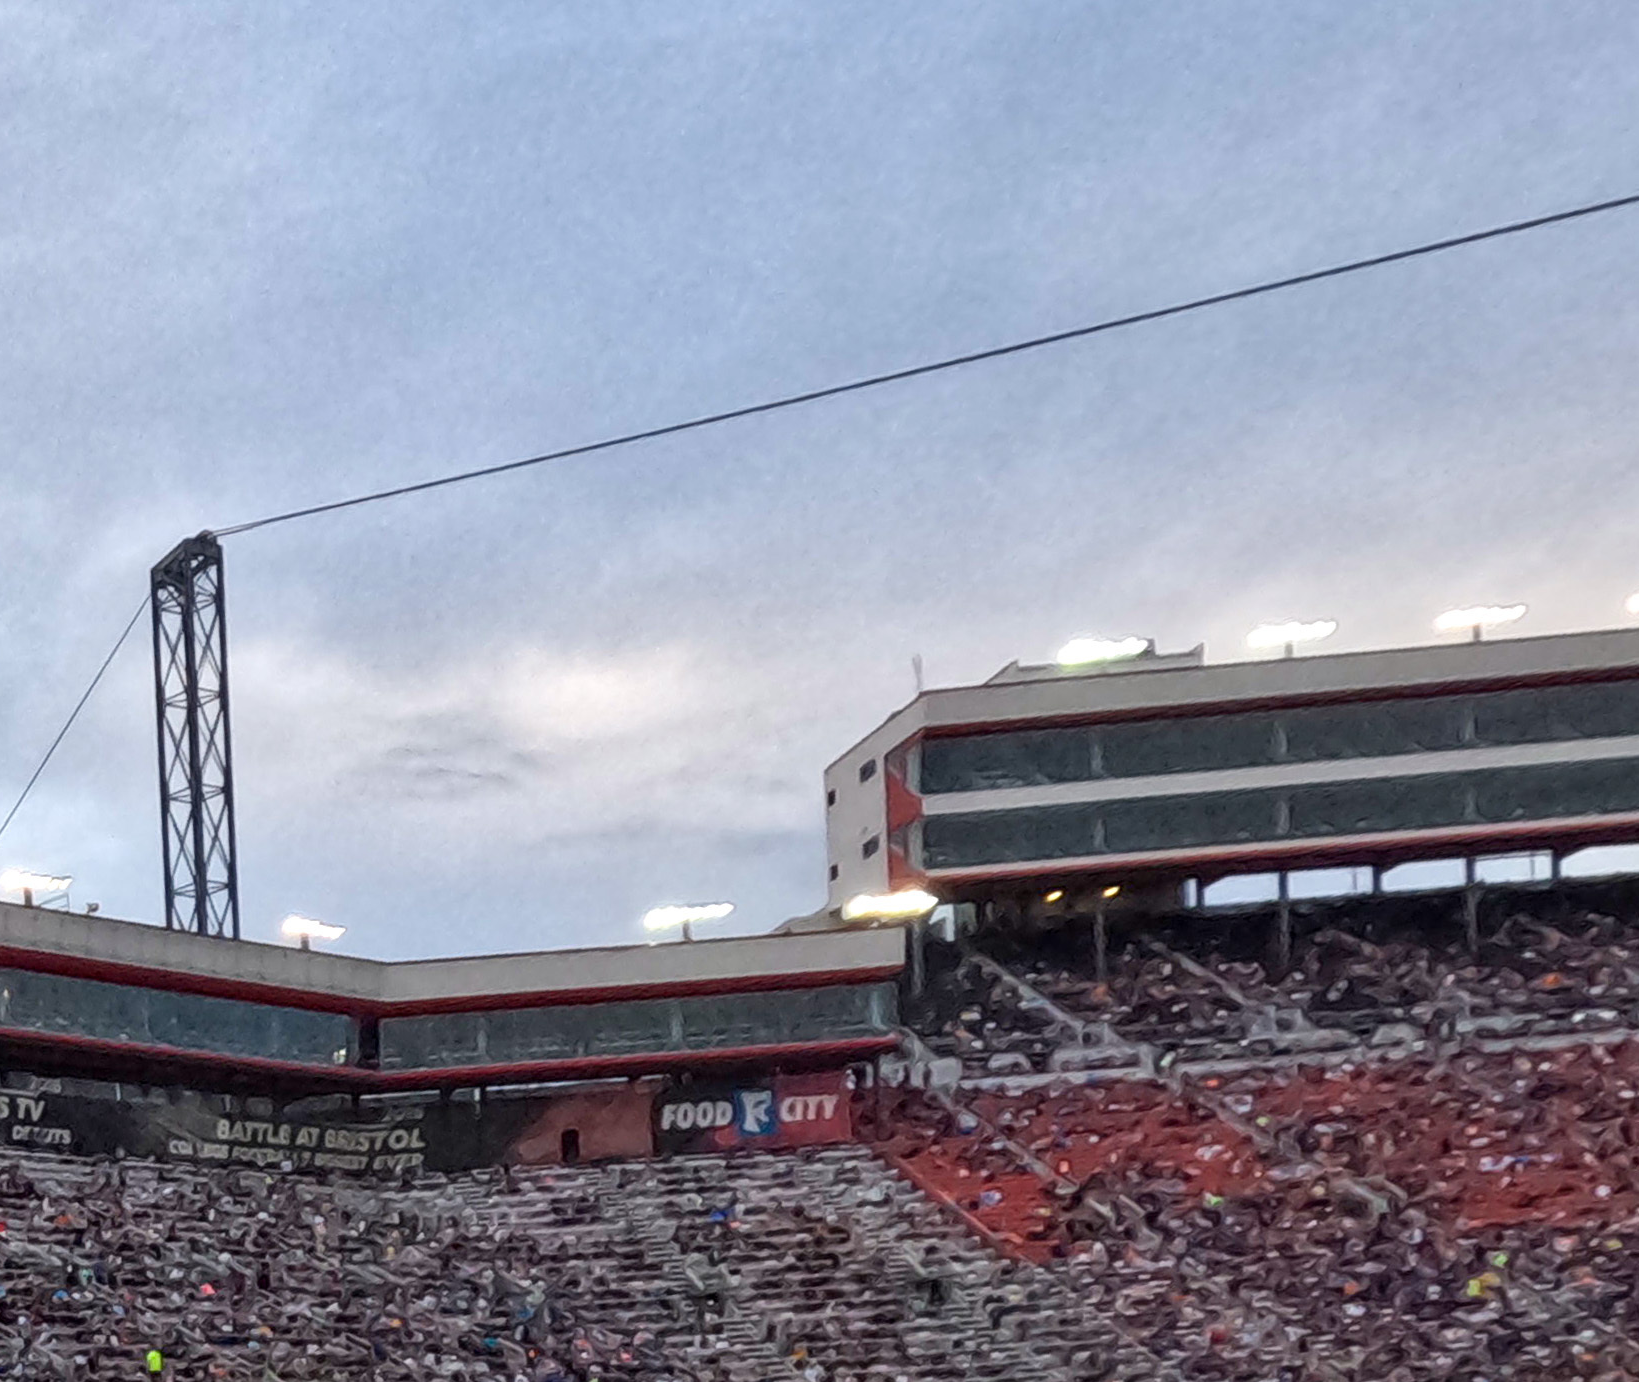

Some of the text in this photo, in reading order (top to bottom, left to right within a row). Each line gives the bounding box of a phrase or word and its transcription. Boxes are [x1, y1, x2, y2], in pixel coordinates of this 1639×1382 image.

[15, 1097, 45, 1122] TV
[661, 1101, 733, 1131] FOOD
[779, 1094, 839, 1123] CITY
[295, 1126, 320, 1147] AT
[325, 1127, 426, 1151] BRISTOL
